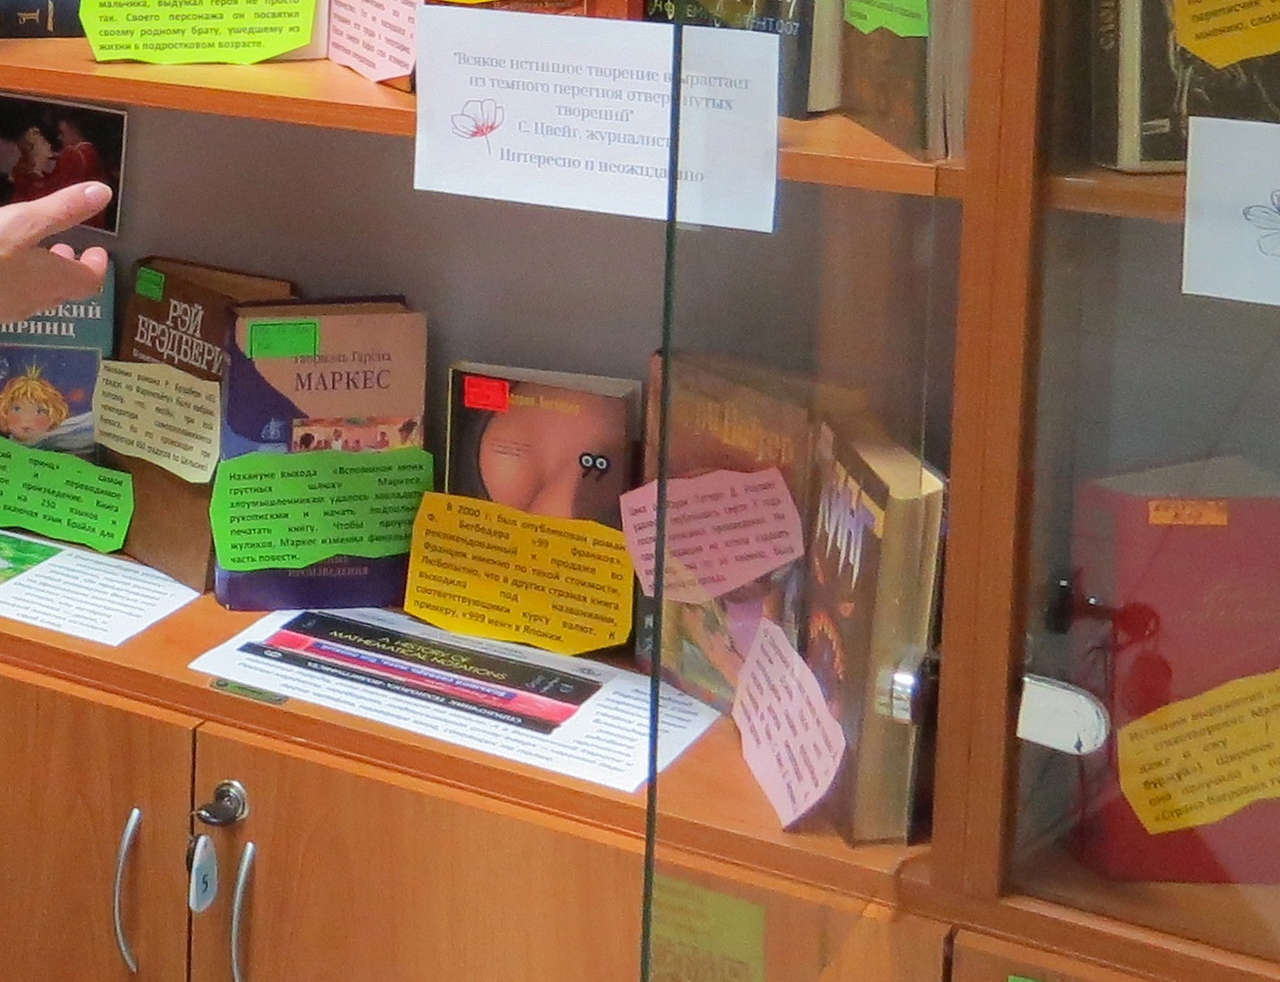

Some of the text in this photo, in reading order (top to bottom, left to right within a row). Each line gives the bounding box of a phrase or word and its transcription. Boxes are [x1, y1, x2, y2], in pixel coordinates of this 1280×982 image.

[140, 27, 185, 37] родному
[510, 59, 583, 75] истинное
[588, 65, 659, 84] творение
[469, 76, 486, 87] из
[553, 83, 623, 101] перегноя
[500, 148, 581, 170] Интересно
[585, 160, 595, 171] и
[0, 320, 76, 338] ПРИНЦ
[166, 298, 204, 338] РЭЙ
[134, 314, 222, 375] БРЭДБЕРИ
[294, 369, 391, 391] МАРКЕС
